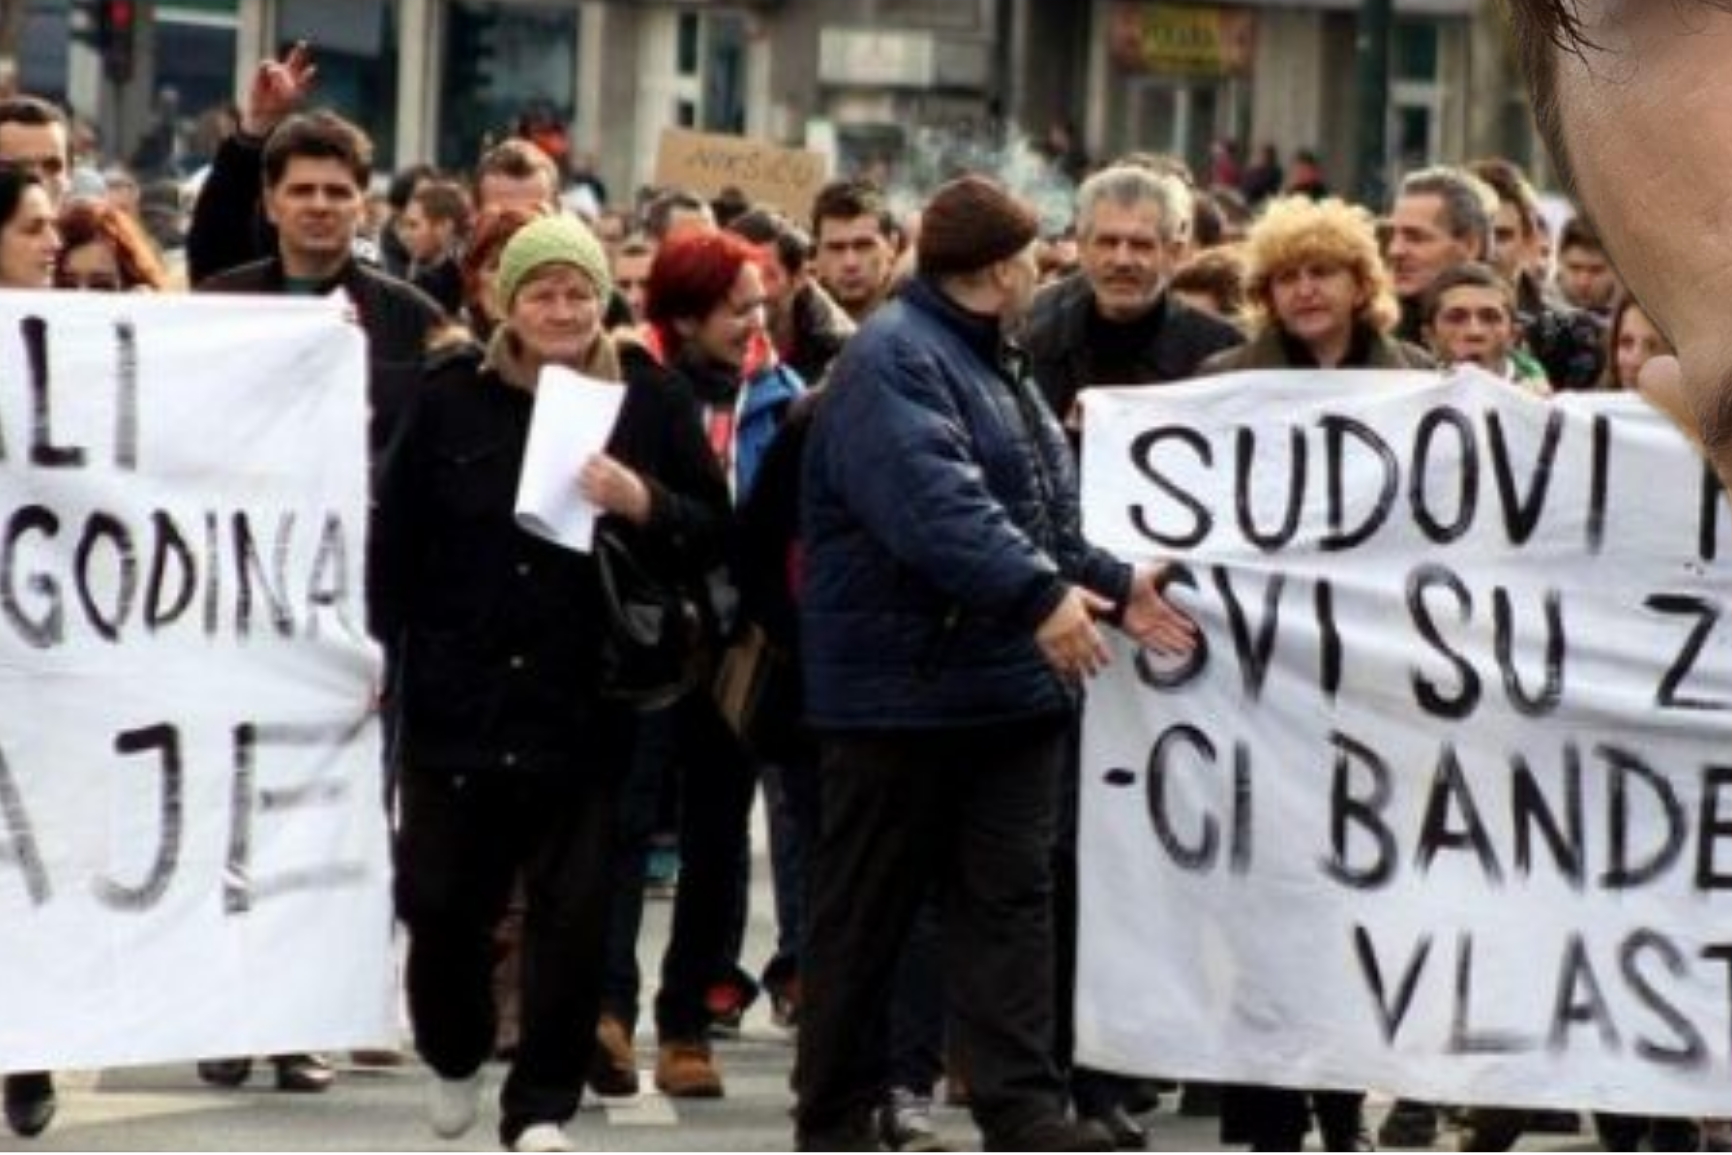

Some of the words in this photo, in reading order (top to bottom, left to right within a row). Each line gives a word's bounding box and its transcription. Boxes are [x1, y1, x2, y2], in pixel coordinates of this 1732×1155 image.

[0, 314, 137, 471] LI
[1128, 406, 1609, 549] SUDOVI
[2, 505, 349, 643] GODINA
[1134, 560, 1344, 703] SVI
[1406, 565, 1567, 720] SU
[1318, 730, 1731, 890] BANDE
